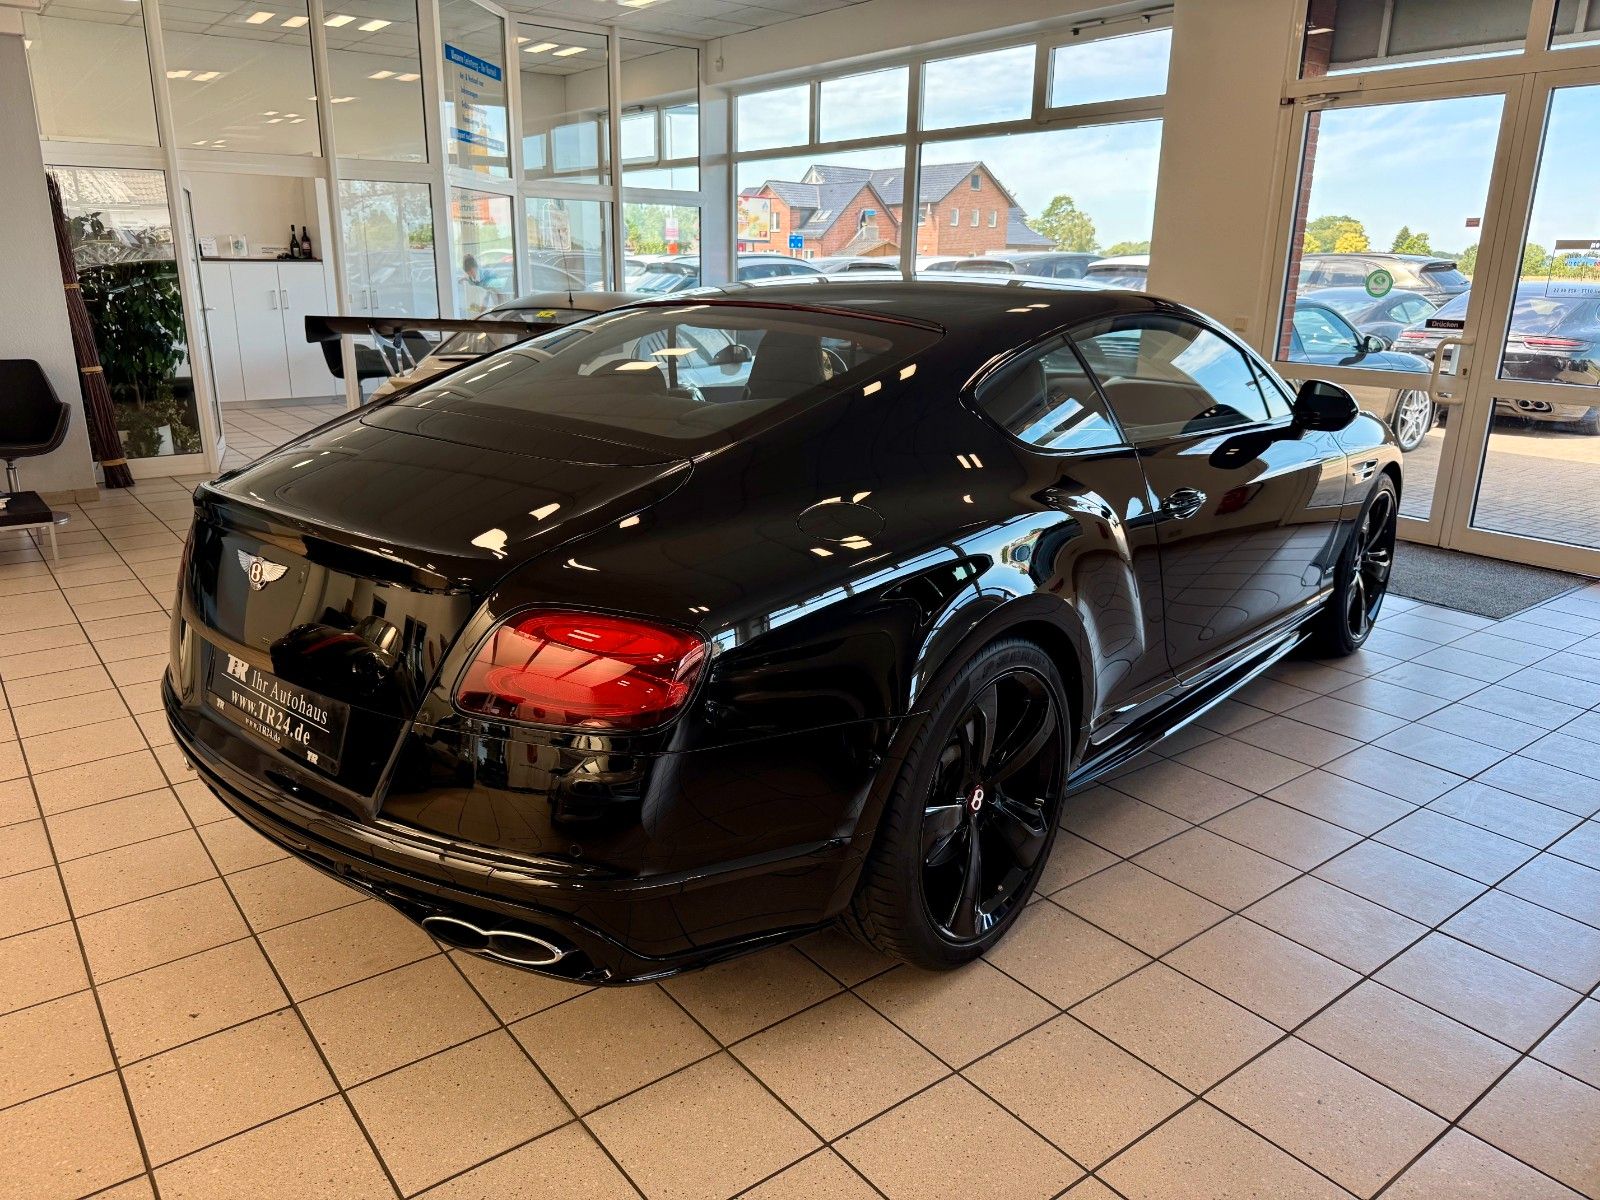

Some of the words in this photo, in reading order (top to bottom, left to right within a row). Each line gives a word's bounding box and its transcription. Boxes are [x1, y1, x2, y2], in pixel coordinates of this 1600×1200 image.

[1431, 320, 1459, 328] Drücken
[231, 690, 310, 745] www.TR24.de
[251, 669, 268, 693] Ihr
[270, 681, 328, 725] Autohaus
[245, 717, 281, 744] www.TR24.de
